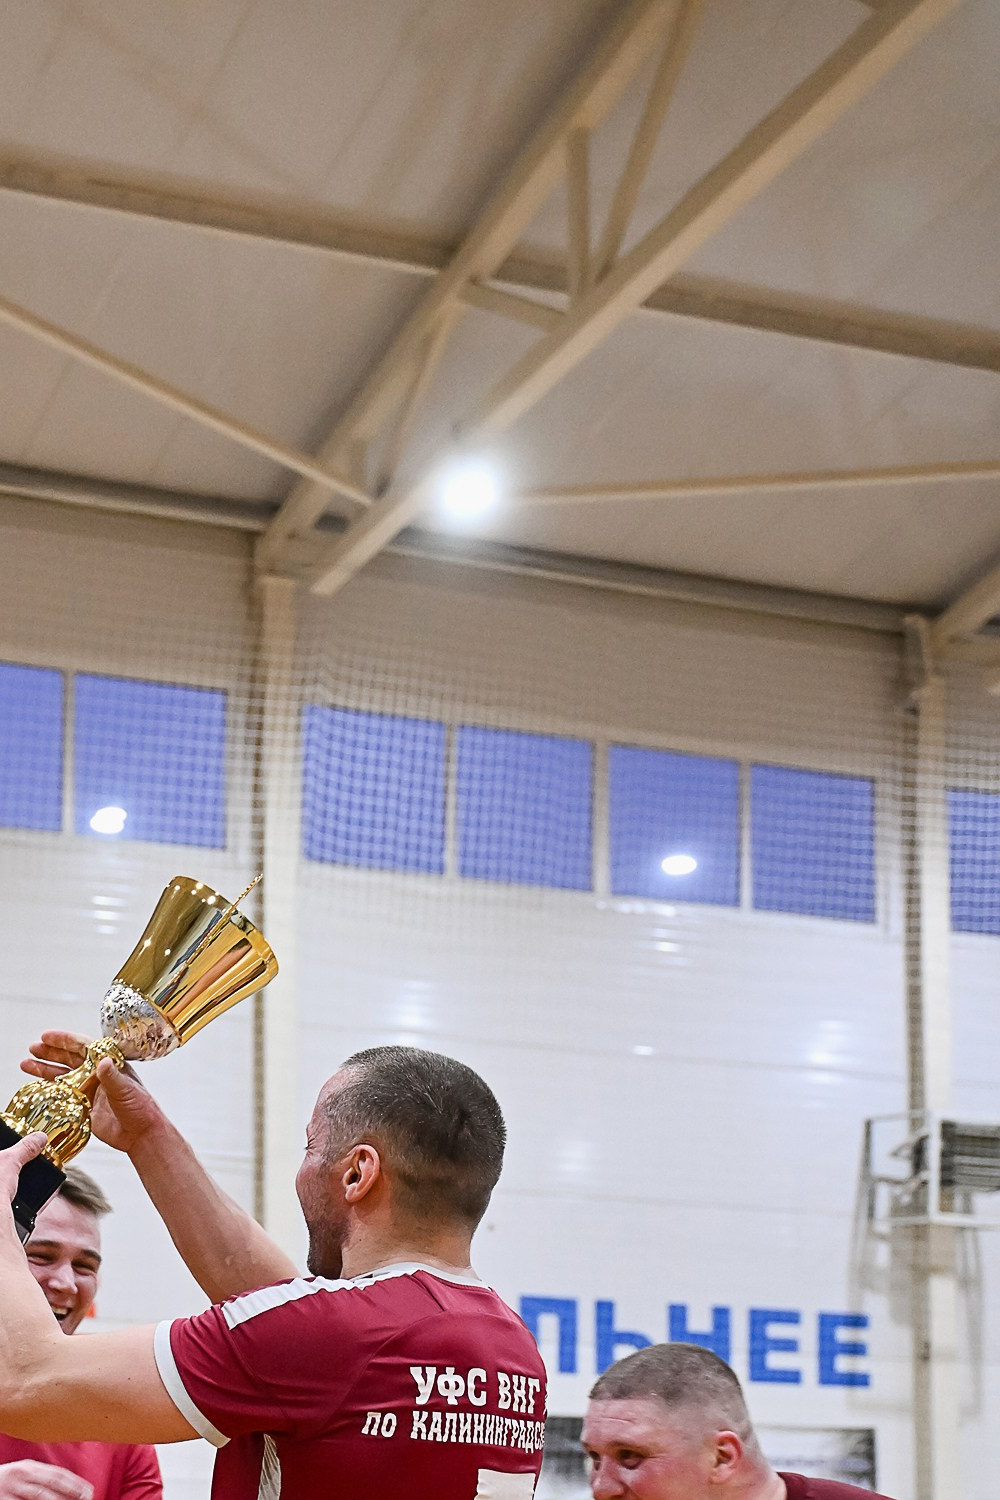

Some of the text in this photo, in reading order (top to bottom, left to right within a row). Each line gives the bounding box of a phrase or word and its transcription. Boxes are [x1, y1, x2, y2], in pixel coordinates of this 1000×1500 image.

[410, 1366, 487, 1407] УФС
[497, 1371, 541, 1414] ВНГ
[361, 1411, 397, 1438] ПО
